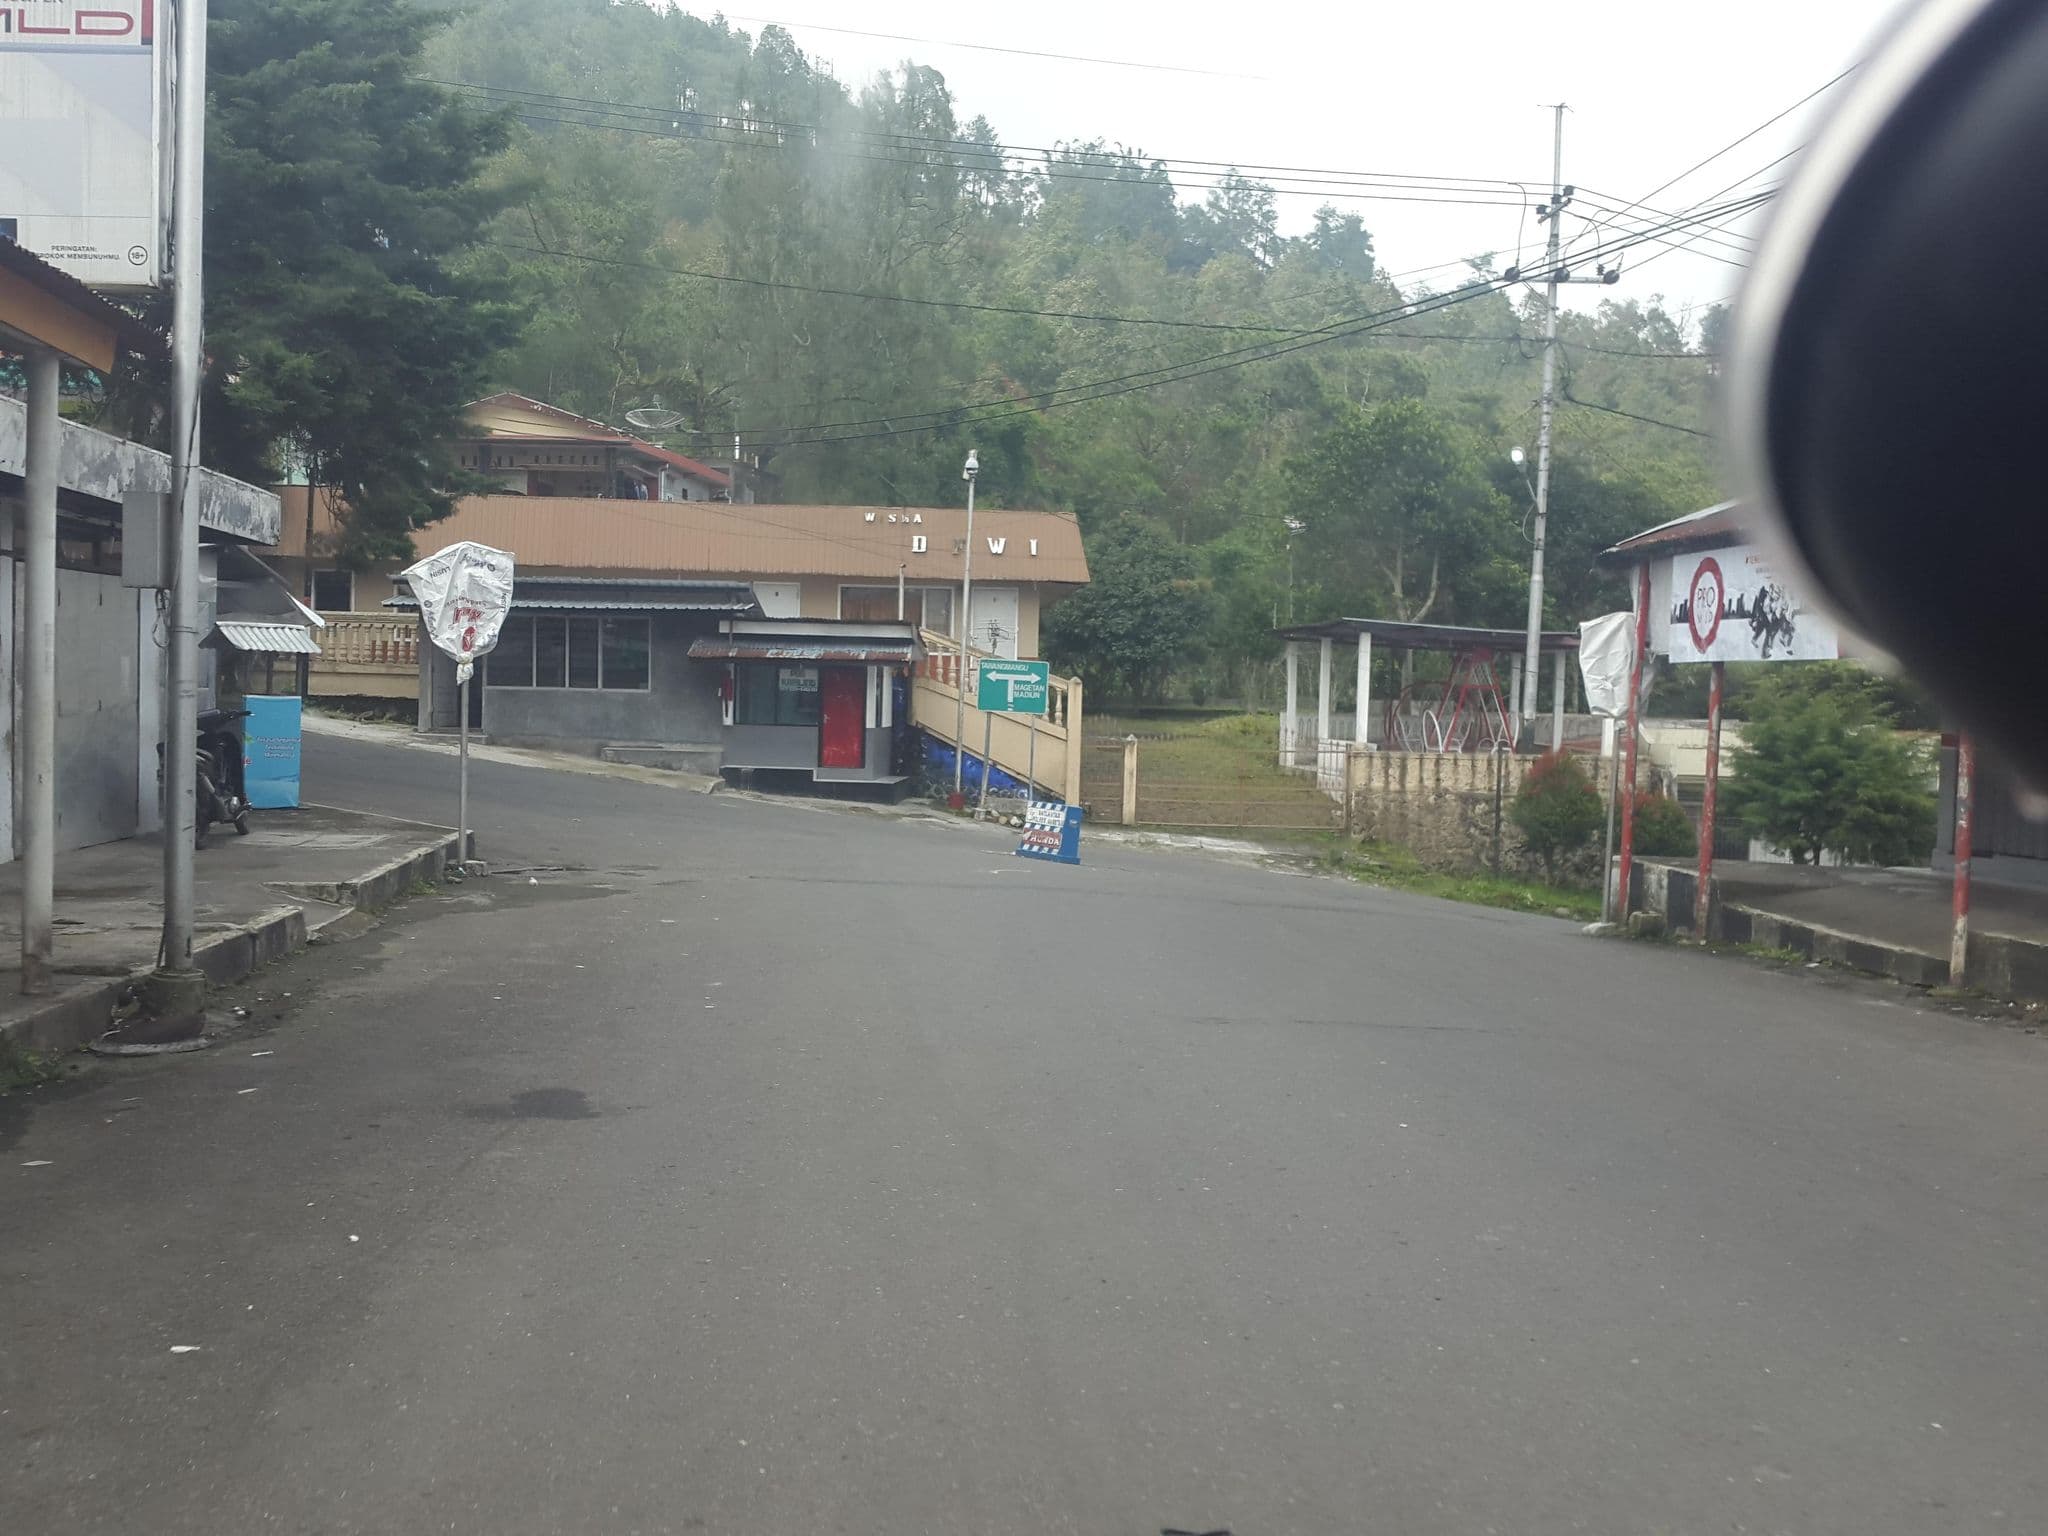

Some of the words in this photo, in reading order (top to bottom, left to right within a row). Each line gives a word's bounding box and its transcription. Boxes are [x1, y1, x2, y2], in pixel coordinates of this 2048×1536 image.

[131, 252, 145, 260] 18+
[981, 662, 1029, 671] TAWANGMANGU
[1014, 684, 1045, 692] MAGETAN
